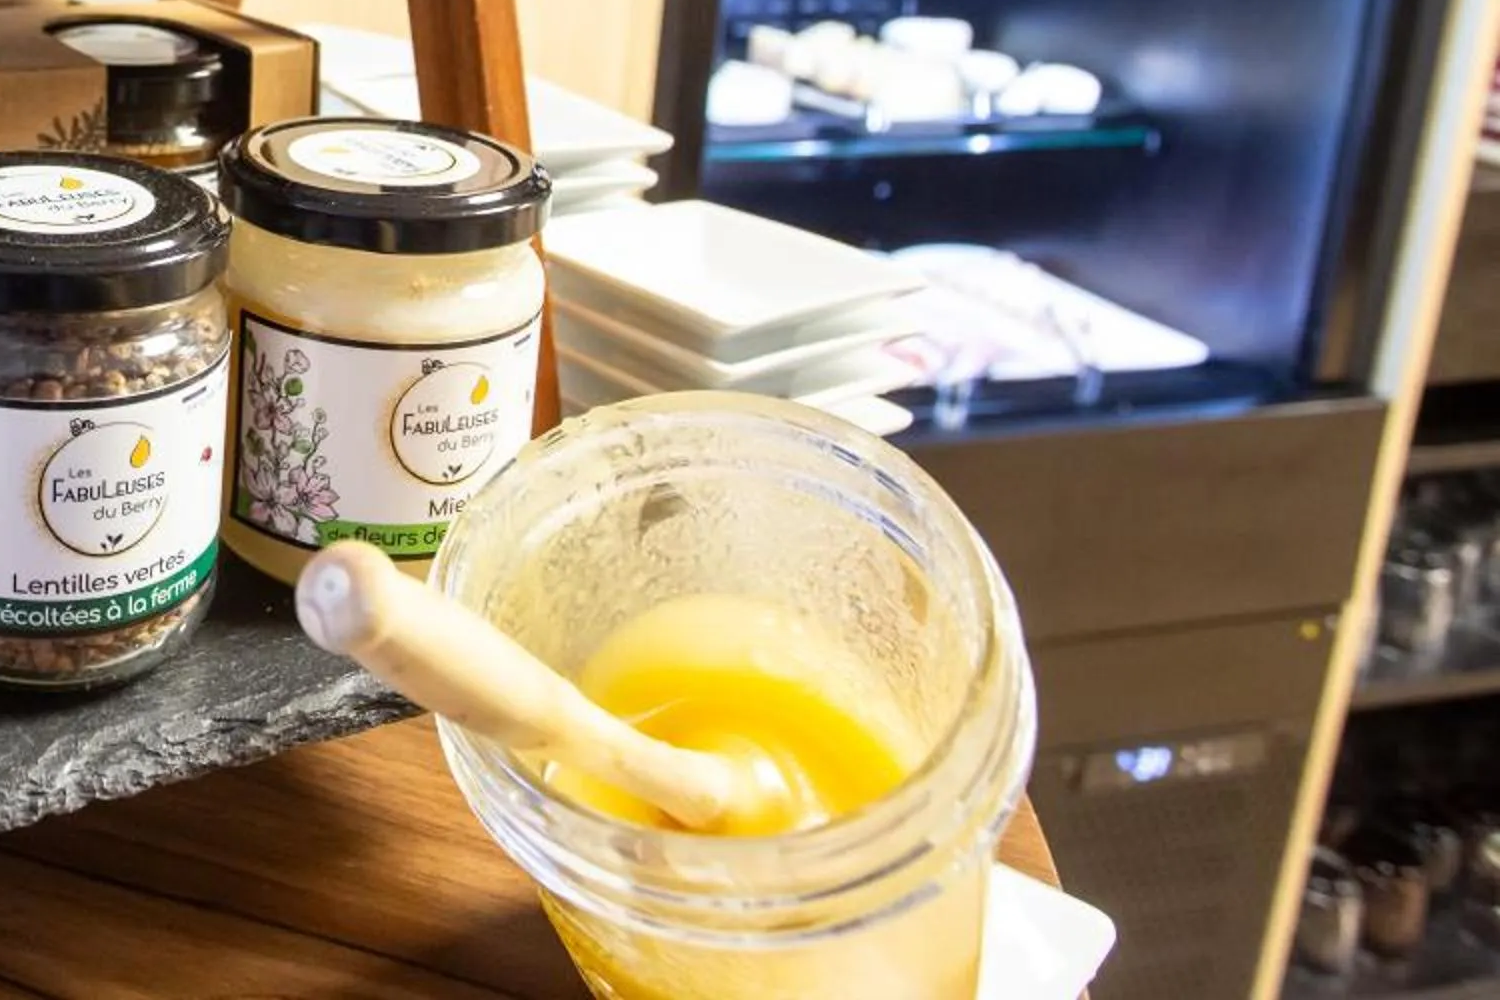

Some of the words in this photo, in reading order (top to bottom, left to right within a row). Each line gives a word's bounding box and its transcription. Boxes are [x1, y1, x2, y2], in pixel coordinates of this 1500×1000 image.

[417, 403, 439, 414] Les
[436, 436, 457, 453] du
[68, 467, 92, 480] Les
[93, 506, 117, 521] du
[121, 495, 164, 517] Berry
[354, 525, 417, 547] fleurs
[12, 569, 119, 596] Lentilles
[124, 549, 187, 585] vertes
[106, 600, 121, 621] à
[128, 594, 146, 614] la
[149, 568, 198, 609] ferme
